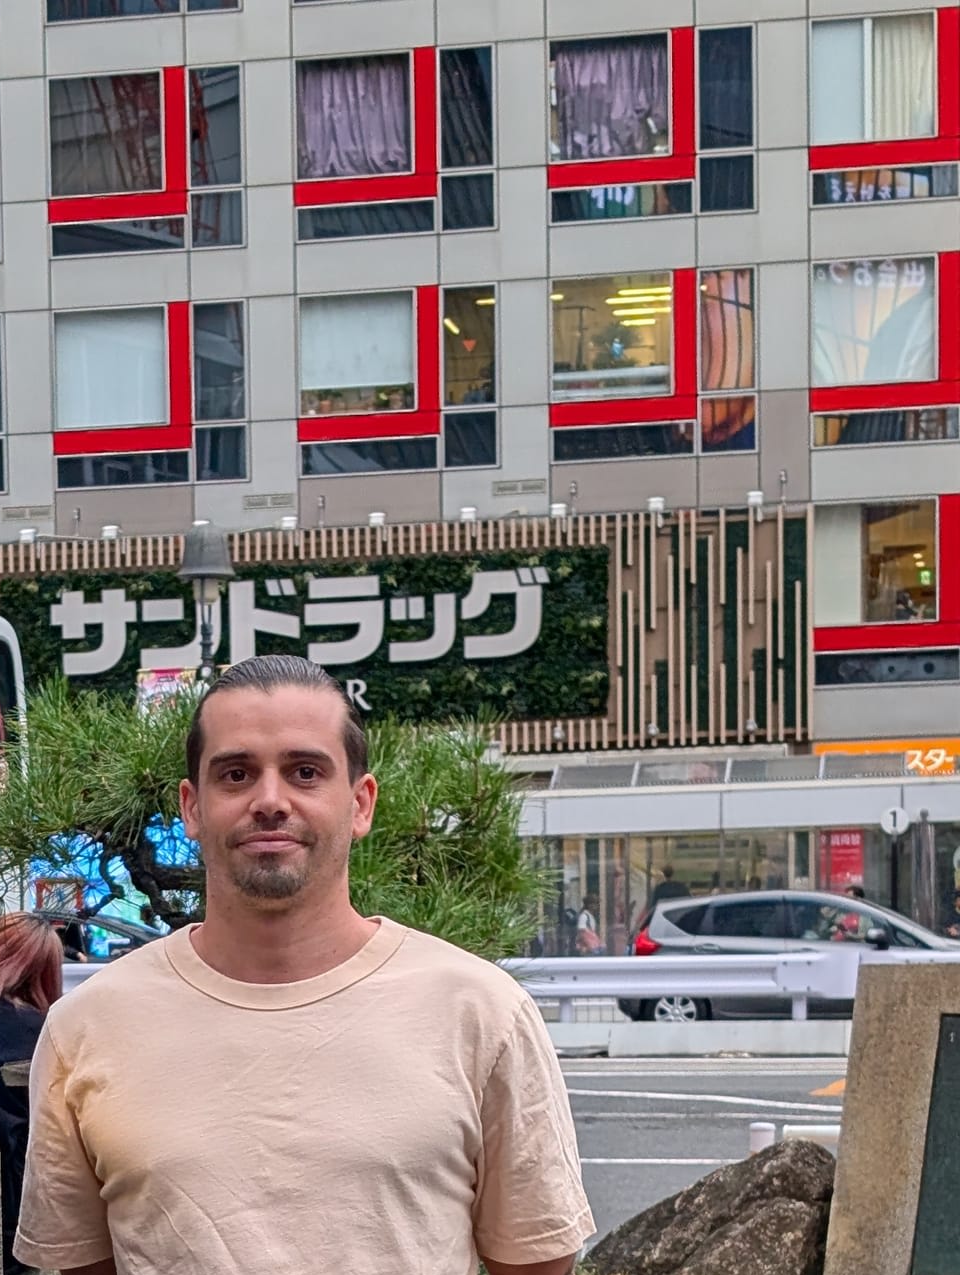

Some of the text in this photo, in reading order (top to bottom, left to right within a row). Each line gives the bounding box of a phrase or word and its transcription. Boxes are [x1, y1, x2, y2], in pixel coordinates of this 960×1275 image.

[50, 566, 550, 676] サンドラッグ
[890, 810, 897, 828] 1
